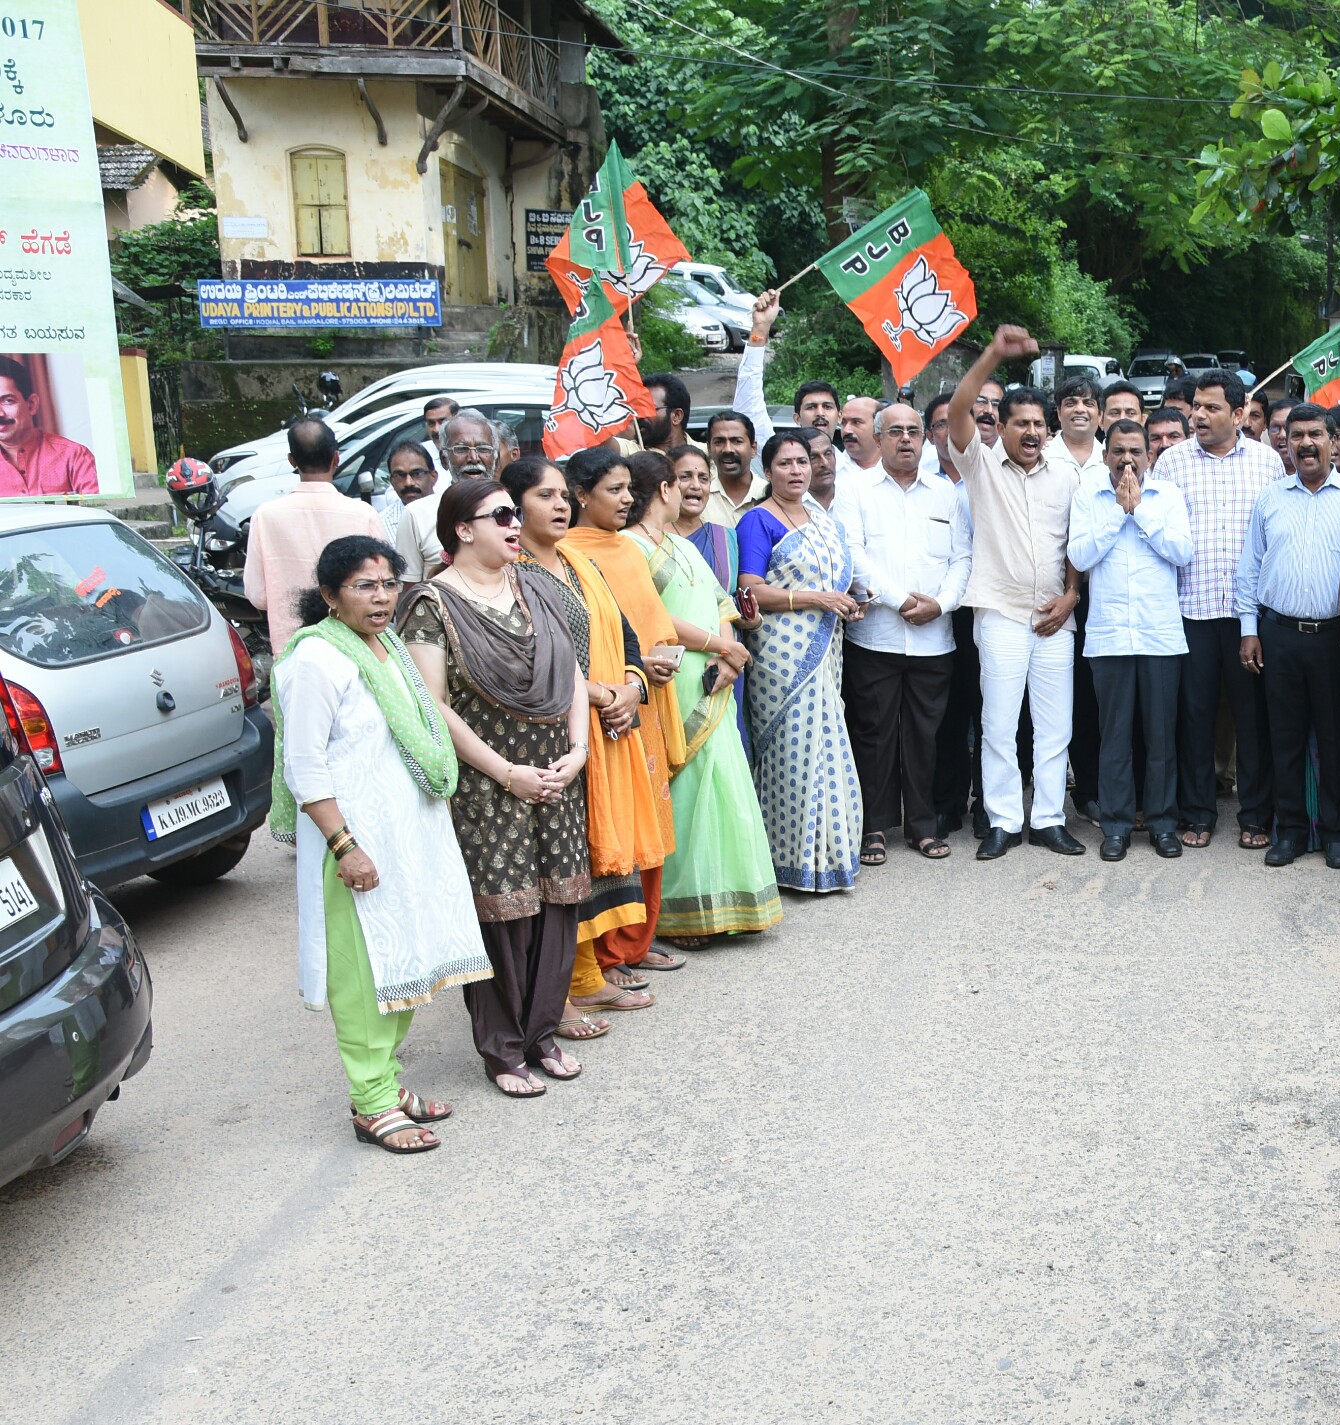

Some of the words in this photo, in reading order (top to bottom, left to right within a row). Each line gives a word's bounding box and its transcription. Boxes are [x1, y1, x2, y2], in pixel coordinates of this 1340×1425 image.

[0, 58, 25, 95] ಕ್ಕೆ
[20, 229, 72, 255] ಹೆಗಡೆ
[840, 217, 912, 278] BJP
[201, 302, 242, 317] UDAYA
[24, 325, 86, 341] ಬಯಸುವ
